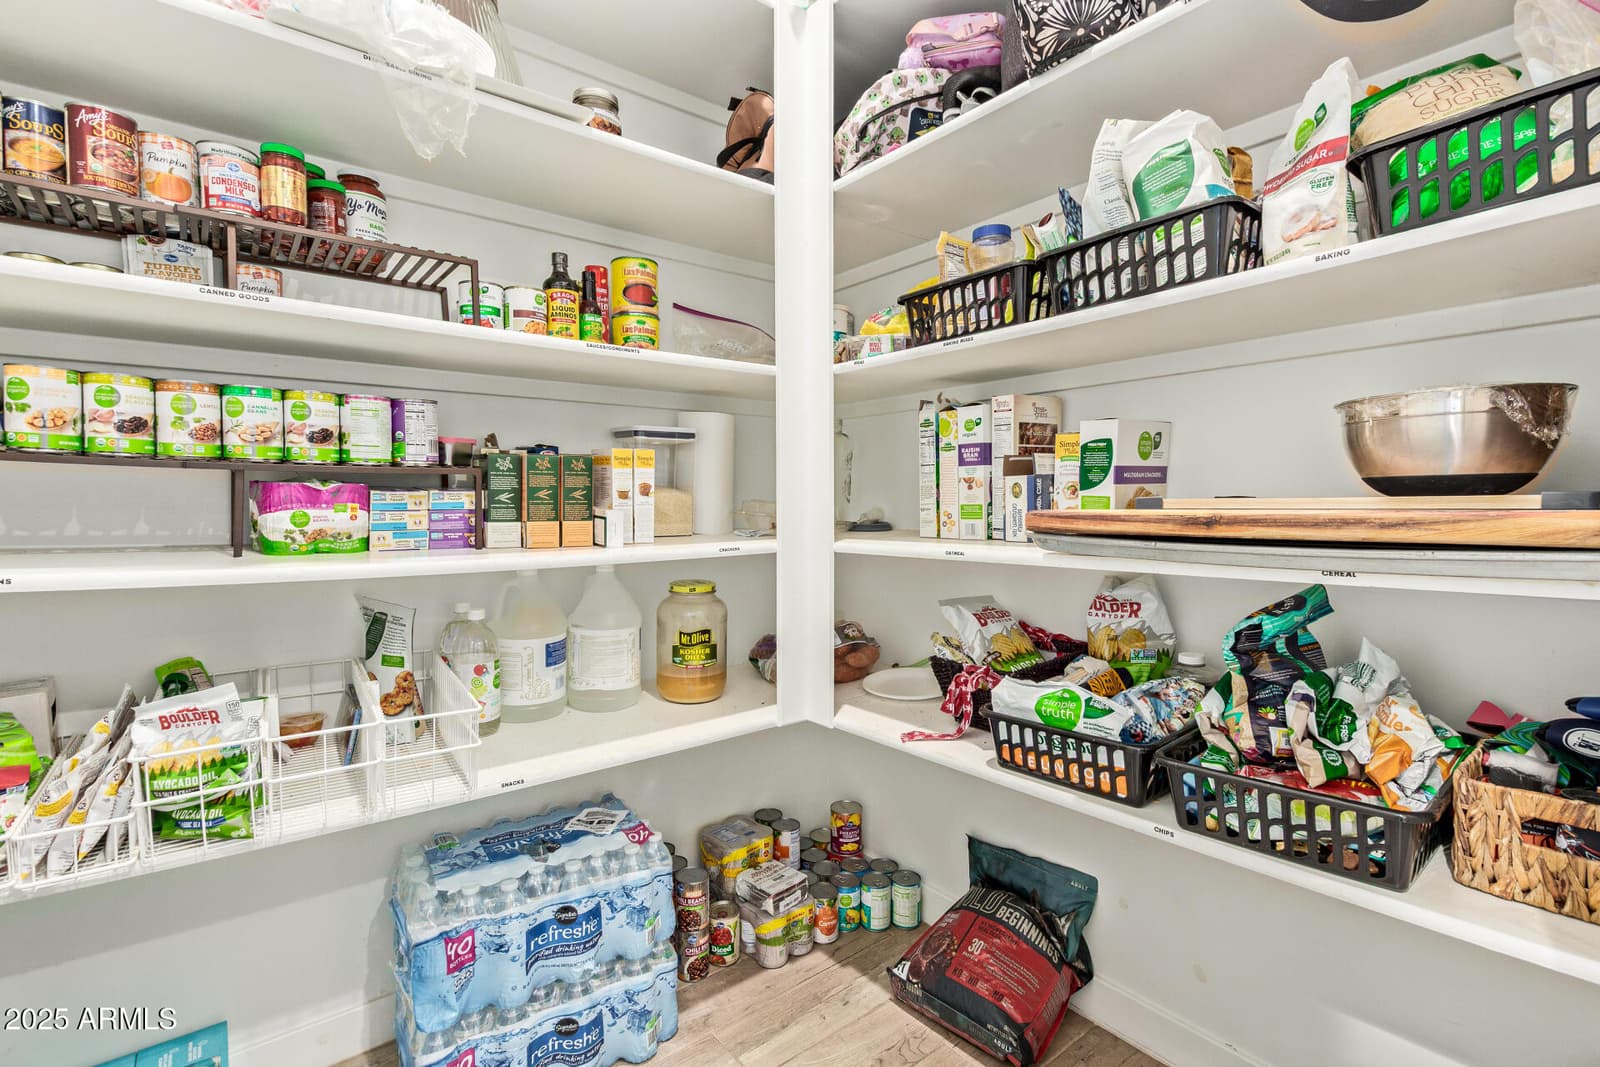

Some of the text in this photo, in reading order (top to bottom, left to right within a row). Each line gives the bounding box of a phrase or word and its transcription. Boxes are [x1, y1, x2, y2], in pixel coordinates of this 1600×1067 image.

[1412, 73, 1501, 109] CANE
[1419, 86, 1507, 120] SUGAR
[75, 109, 110, 127] Amy's
[9, 113, 63, 140] SOUPS
[146, 151, 187, 169] Pumpkin
[1296, 149, 1327, 171] SUGAR
[212, 177, 256, 192] CONDENSED
[1311, 181, 1333, 190] FREE
[225, 187, 245, 197] MILK
[347, 198, 363, 216] Yo
[1315, 248, 1350, 262] BAKING
[144, 262, 200, 274] TURKEY
[144, 269, 201, 280] FLAVORED
[200, 287, 270, 303] CANNED GOODS
[241, 281, 275, 295] Pumpkin
[550, 311, 577, 320] AMINOS
[552, 305, 576, 314] LIQUID
[1321, 570, 1357, 578] CEREAL
[973, 609, 1012, 627] BOULDE
[691, 633, 710, 643] Olive
[680, 648, 711, 656] KOSHER
[1043, 698, 1077, 711] simple
[159, 708, 221, 730] BOULDER
[1041, 706, 1075, 721] truth
[175, 720, 208, 728] CANYON
[153, 775, 198, 790] AVOCADO
[501, 779, 525, 788] SNACKS
[209, 808, 224, 818] OIL
[1153, 826, 1175, 838] CHIPS
[996, 905, 1061, 964] BEGINNINGS
[447, 935, 473, 960] 40
[711, 945, 733, 953] Diced
